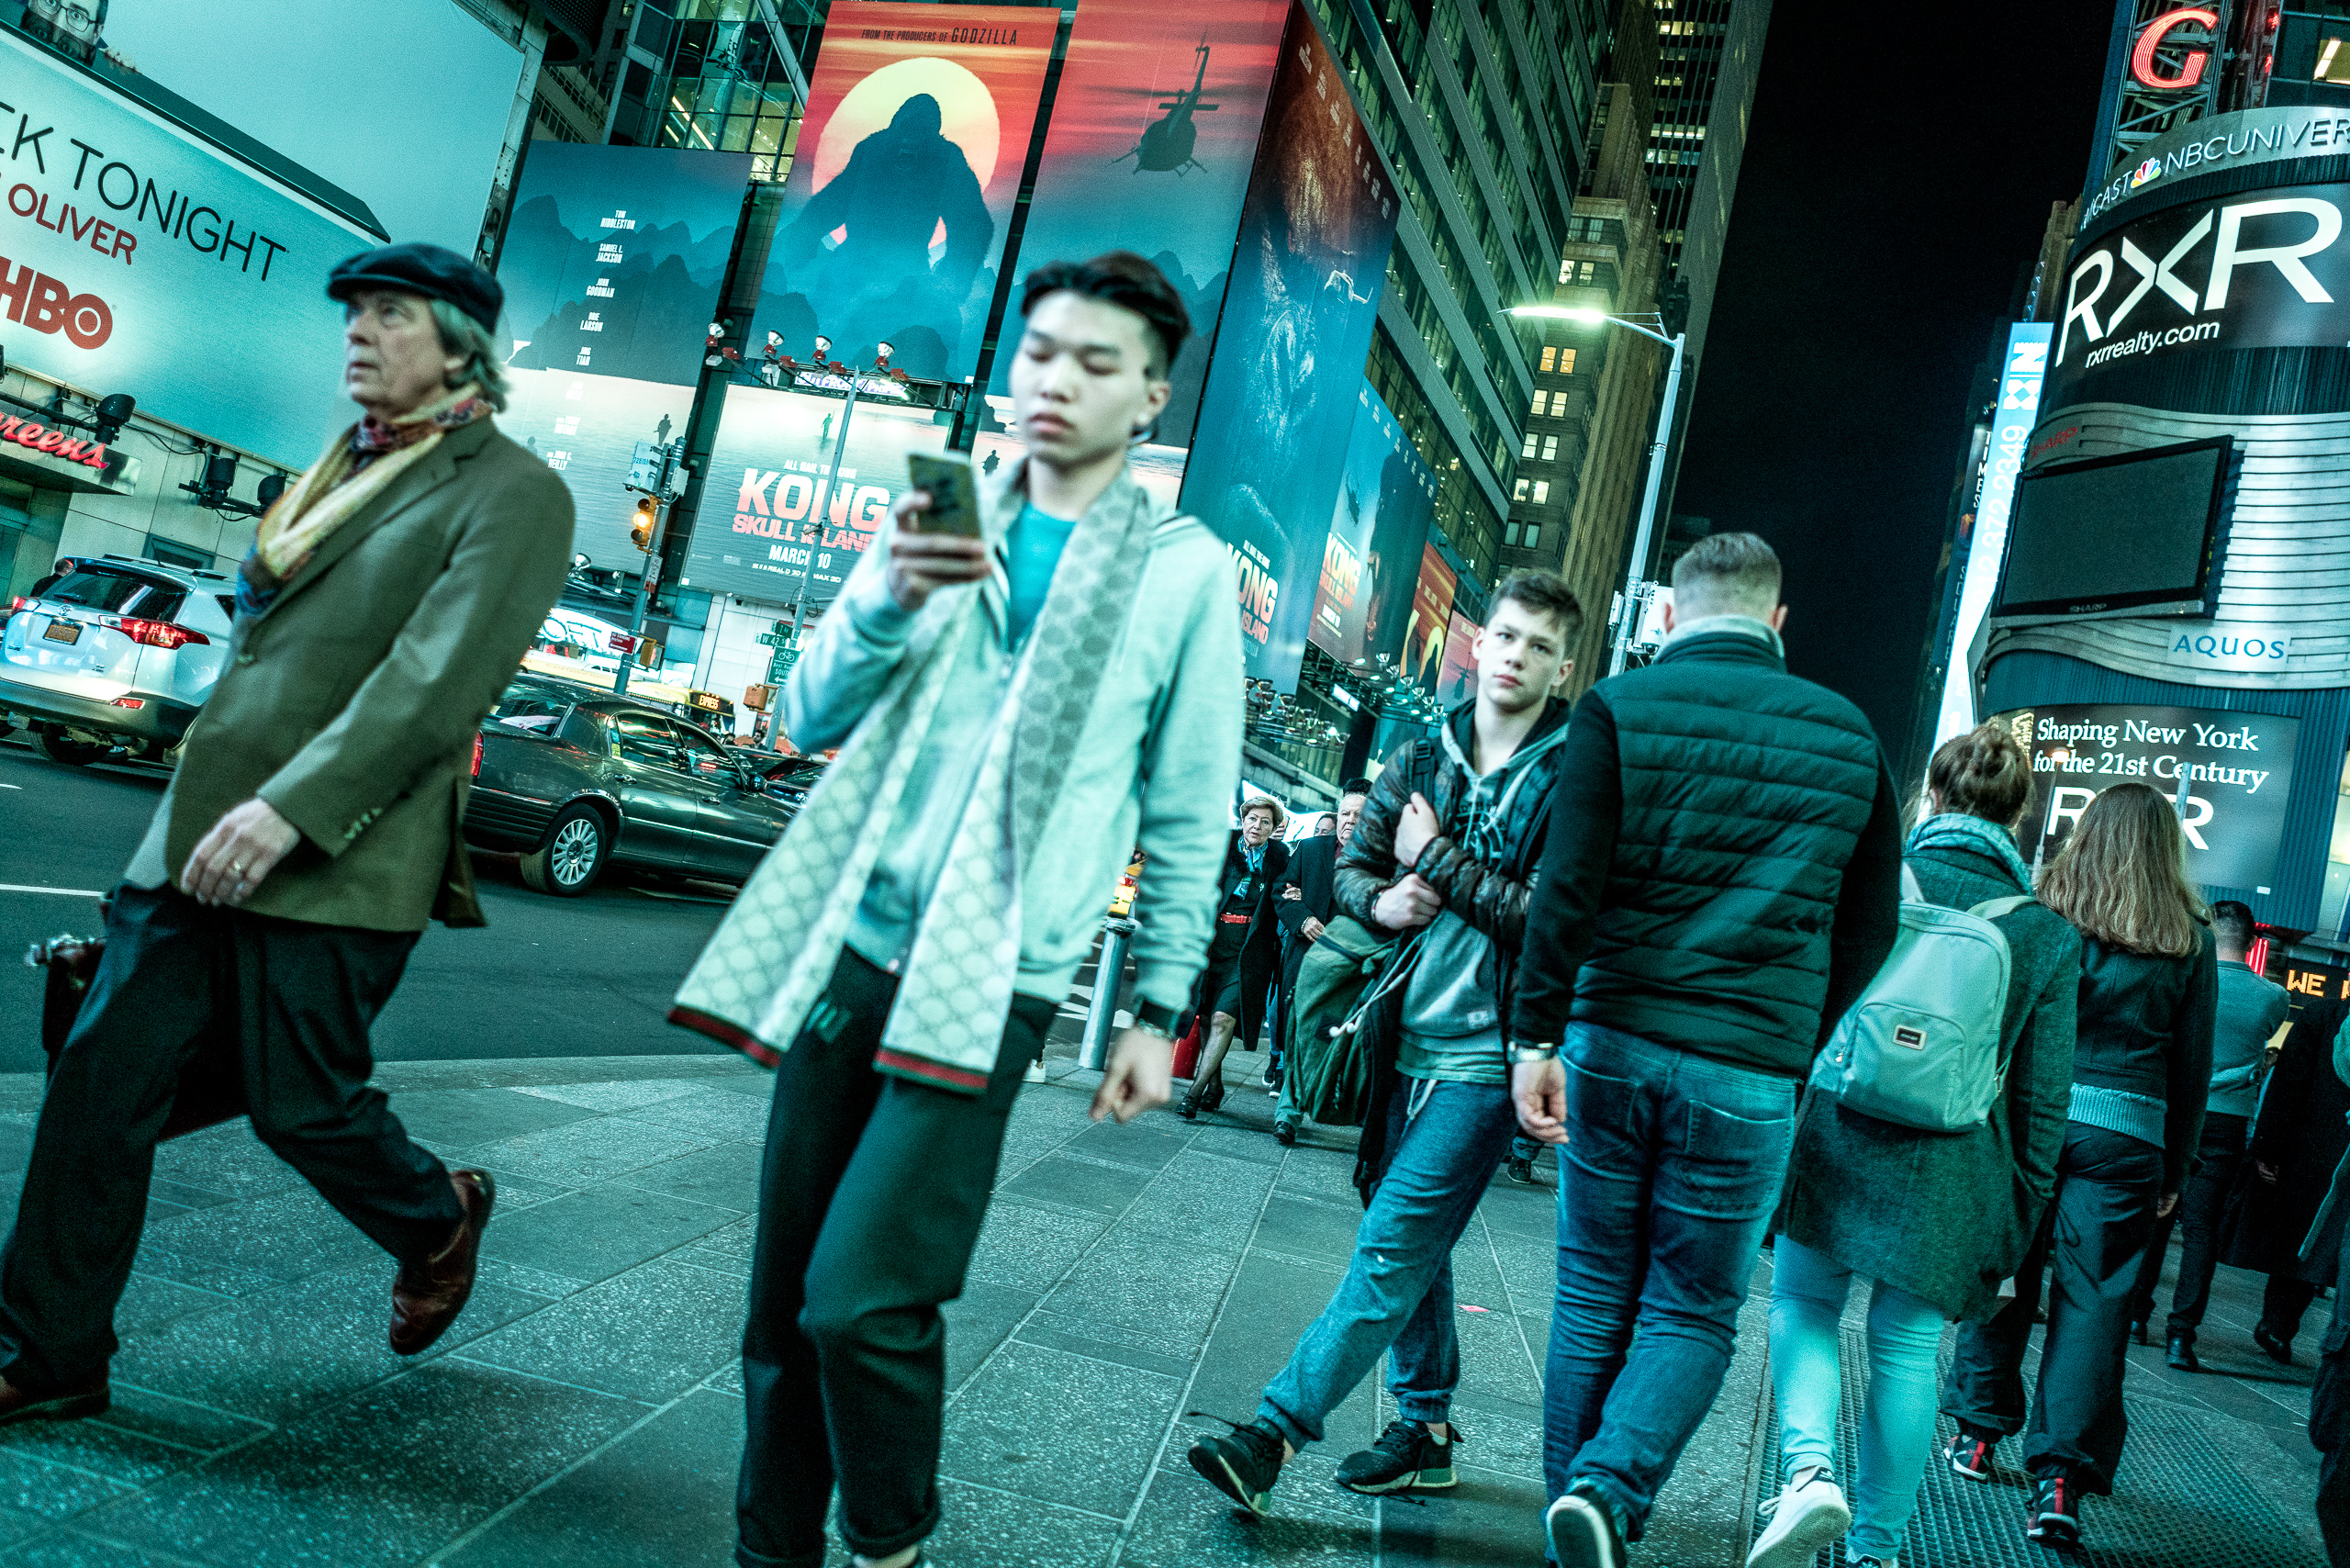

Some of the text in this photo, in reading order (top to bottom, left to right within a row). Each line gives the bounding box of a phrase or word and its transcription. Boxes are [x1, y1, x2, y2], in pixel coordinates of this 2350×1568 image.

[862, 28, 1017, 45] FROM THE PRODUCERS OF GODZILLA
[2132, 8, 2219, 88] G
[8, 184, 137, 265] OLIVER
[71, 138, 287, 282] TONIGHT
[596, 252, 623, 263] JACKSON
[586, 286, 615, 297] GOODMAN
[2055, 197, 2343, 368] RXR
[0, 255, 113, 350] HBO
[580, 319, 604, 331] LARSON
[2086, 321, 2220, 368] rxrrealty.com
[0, 412, 110, 469] reens
[2030, 427, 2077, 461] SHARP
[783, 459, 798, 471] ALL
[800, 461, 817, 474] HAIL
[819, 465, 831, 476] TH
[736, 467, 890, 532] KONG
[733, 513, 796, 543] SKULL
[767, 566, 785, 574] REAL
[817, 552, 832, 569] 10
[1323, 532, 1362, 597] KONG
[2069, 602, 2107, 613] SHARP
[762, 634, 769, 644] W
[771, 636, 780, 646] 42
[1241, 610, 1269, 644] ISLAND
[2173, 634, 2285, 659] AQUOS
[699, 695, 720, 710] EXPRESS
[2037, 717, 2258, 751] Shaping New York
[2033, 749, 2269, 794] for the 21st Century
[2046, 786, 2214, 850] RR
[2287, 969, 2327, 997] WE
